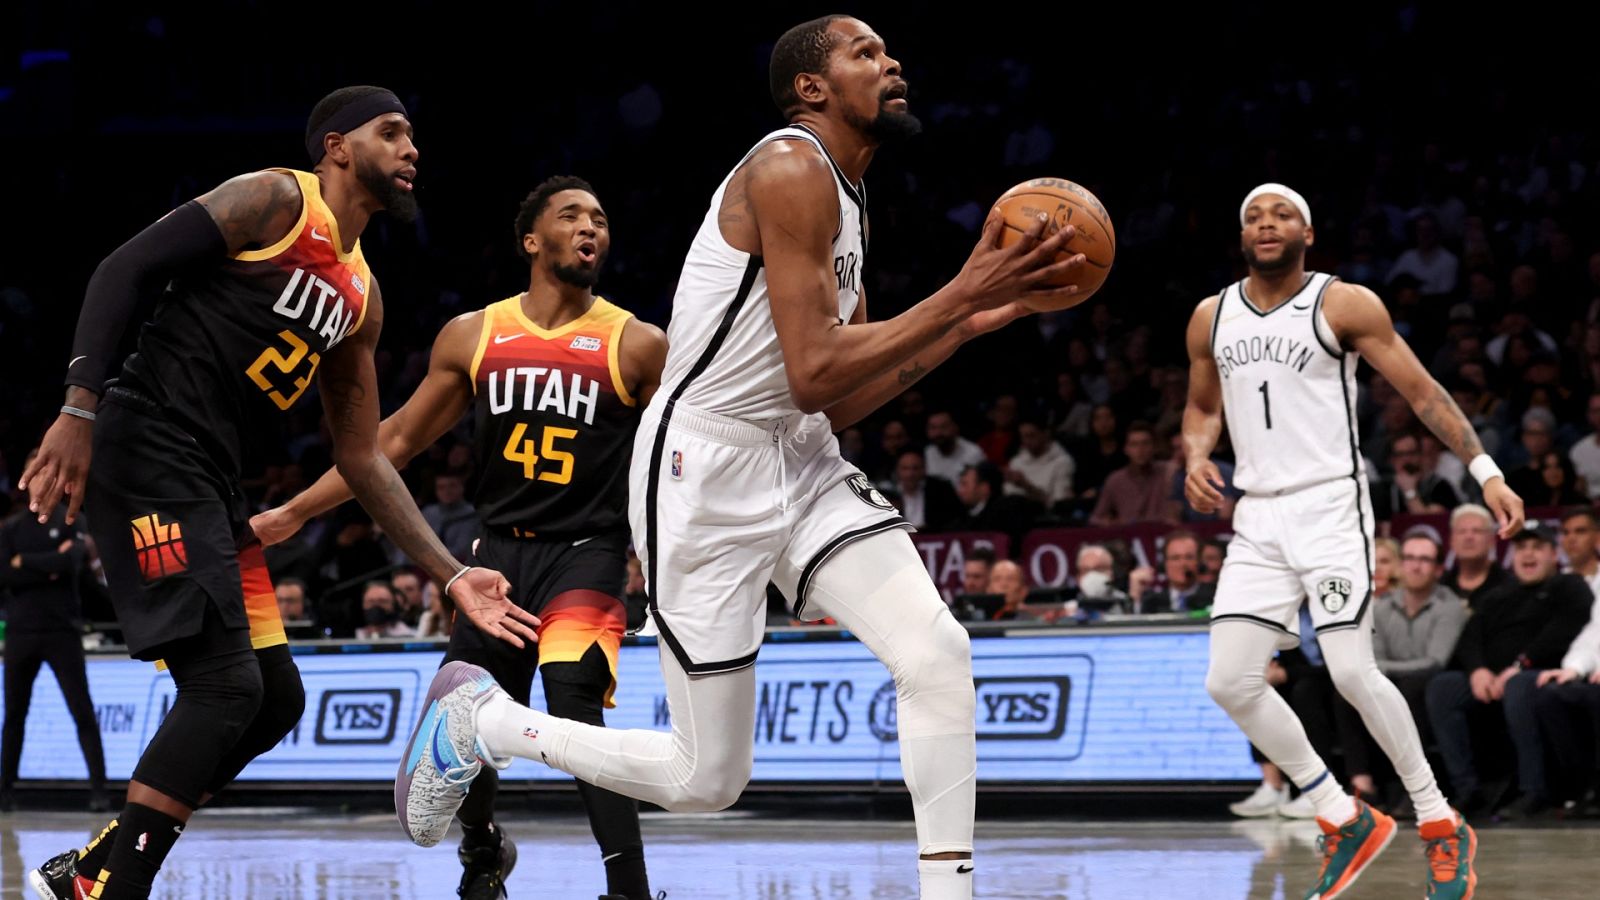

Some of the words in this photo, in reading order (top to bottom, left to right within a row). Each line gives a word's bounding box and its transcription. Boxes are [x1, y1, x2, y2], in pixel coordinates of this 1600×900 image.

[244, 329, 321, 411] 23
[1216, 335, 1315, 379] BROOKLYN
[488, 366, 600, 426] UTAH
[1257, 380, 1273, 430] 1
[502, 422, 579, 485] 45
[1318, 579, 1351, 596] NETS
[333, 703, 386, 730] YES
[755, 680, 853, 743] NETS
[983, 692, 1052, 724] YES
